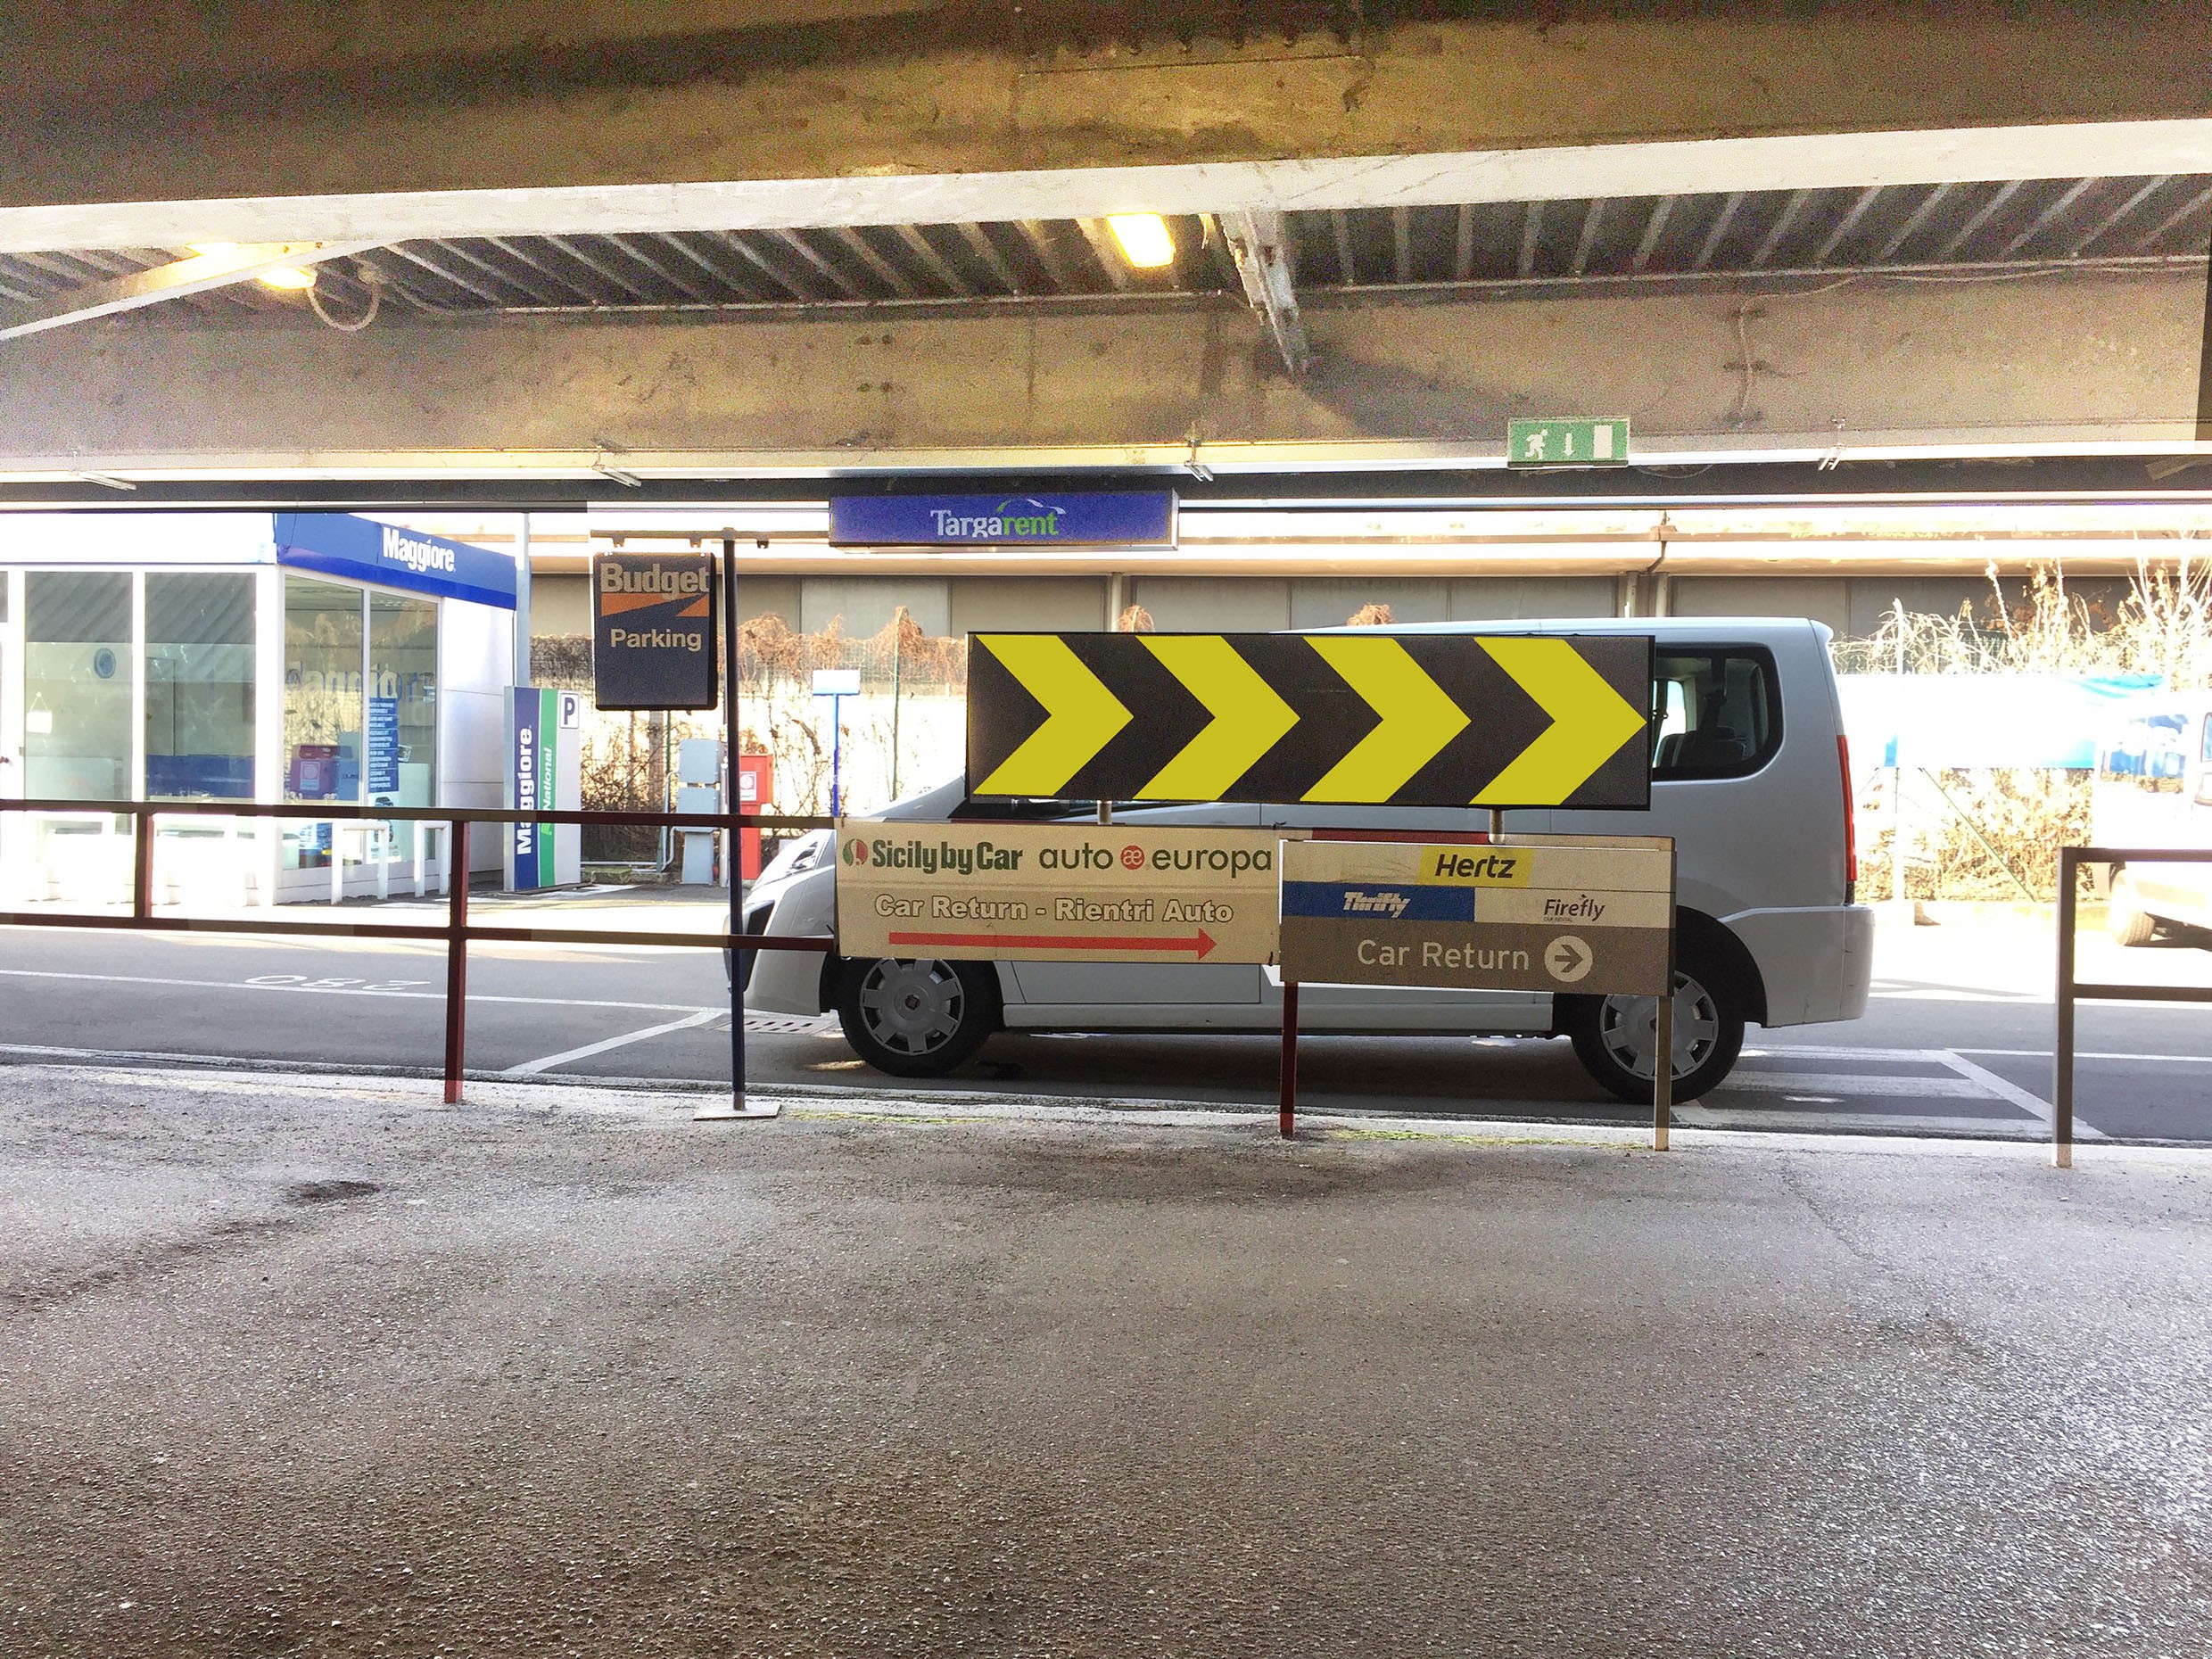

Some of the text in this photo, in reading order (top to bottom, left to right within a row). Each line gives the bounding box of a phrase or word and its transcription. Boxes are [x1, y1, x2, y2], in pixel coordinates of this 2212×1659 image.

[930, 509, 1059, 538] Targarent
[383, 526, 455, 573] Maggiore
[600, 563, 710, 600] Budget
[610, 628, 702, 652] Parking
[564, 697, 576, 725] P
[542, 747, 553, 811] National
[1039, 842, 1114, 870] auto
[1151, 849, 1272, 879] europa
[1434, 854, 1517, 879] Hertz
[875, 894, 925, 917] Car
[931, 895, 1028, 920] Return
[1054, 897, 1154, 922] Rientri
[1161, 899, 1234, 922] Auto
[1343, 892, 1411, 919] Thrifty
[1544, 898, 1605, 922] Firefly
[1357, 939, 1530, 970] Car Return
